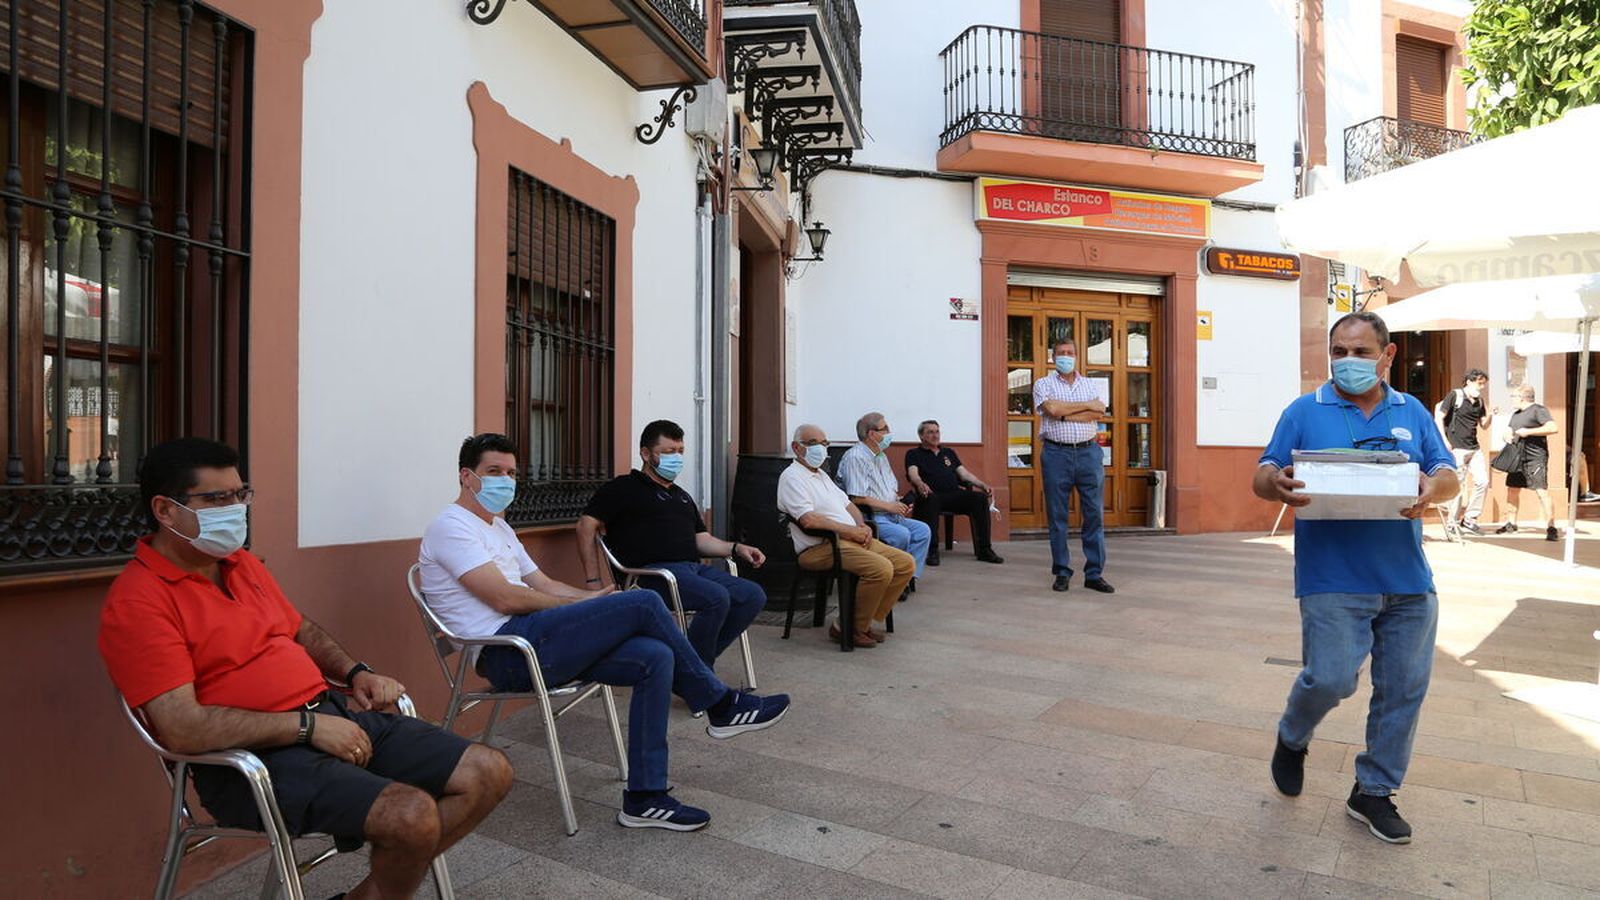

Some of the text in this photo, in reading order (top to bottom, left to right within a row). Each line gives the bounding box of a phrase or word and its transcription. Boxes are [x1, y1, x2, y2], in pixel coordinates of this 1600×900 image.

[1053, 188, 1103, 205] Estanco
[992, 197, 1071, 216] DEL CHARCO
[1236, 254, 1294, 270] TABACOS
